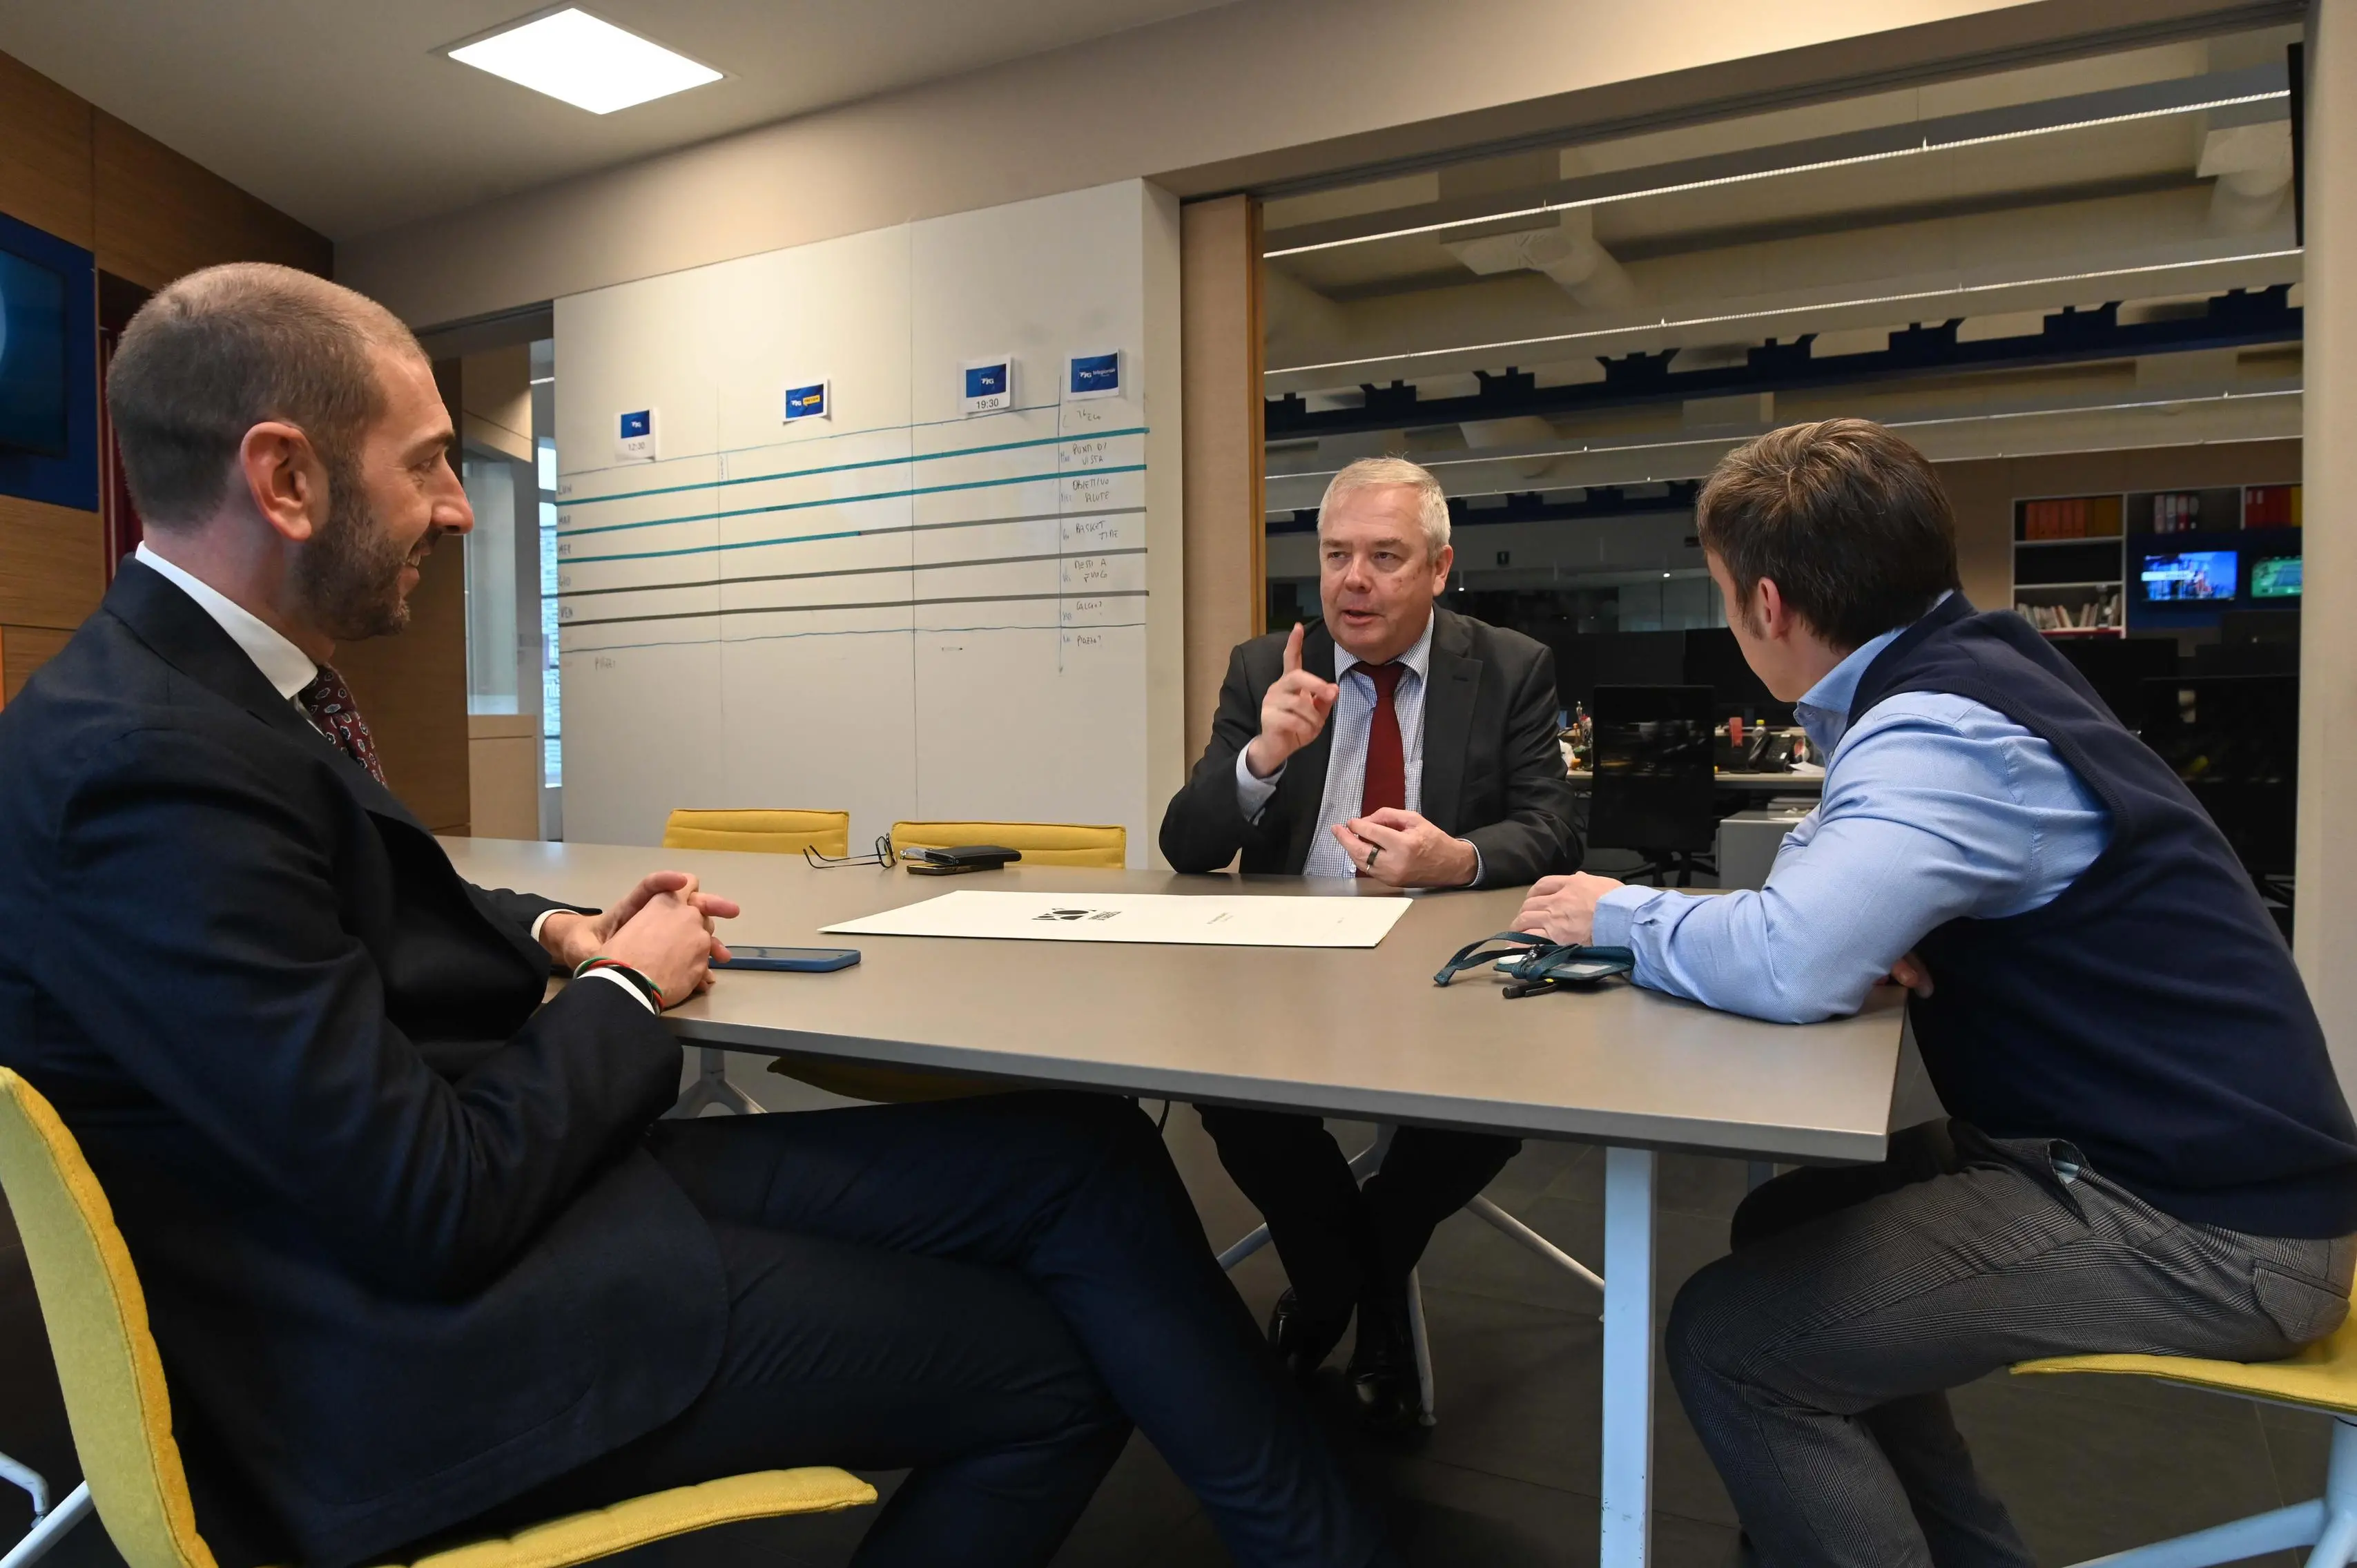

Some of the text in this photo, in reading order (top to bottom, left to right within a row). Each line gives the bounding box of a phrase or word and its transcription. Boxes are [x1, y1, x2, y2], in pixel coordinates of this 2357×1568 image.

[977, 398, 999, 409] 19:30
[628, 442, 646, 451] 12:30
[1076, 520, 1105, 534] BASKET
